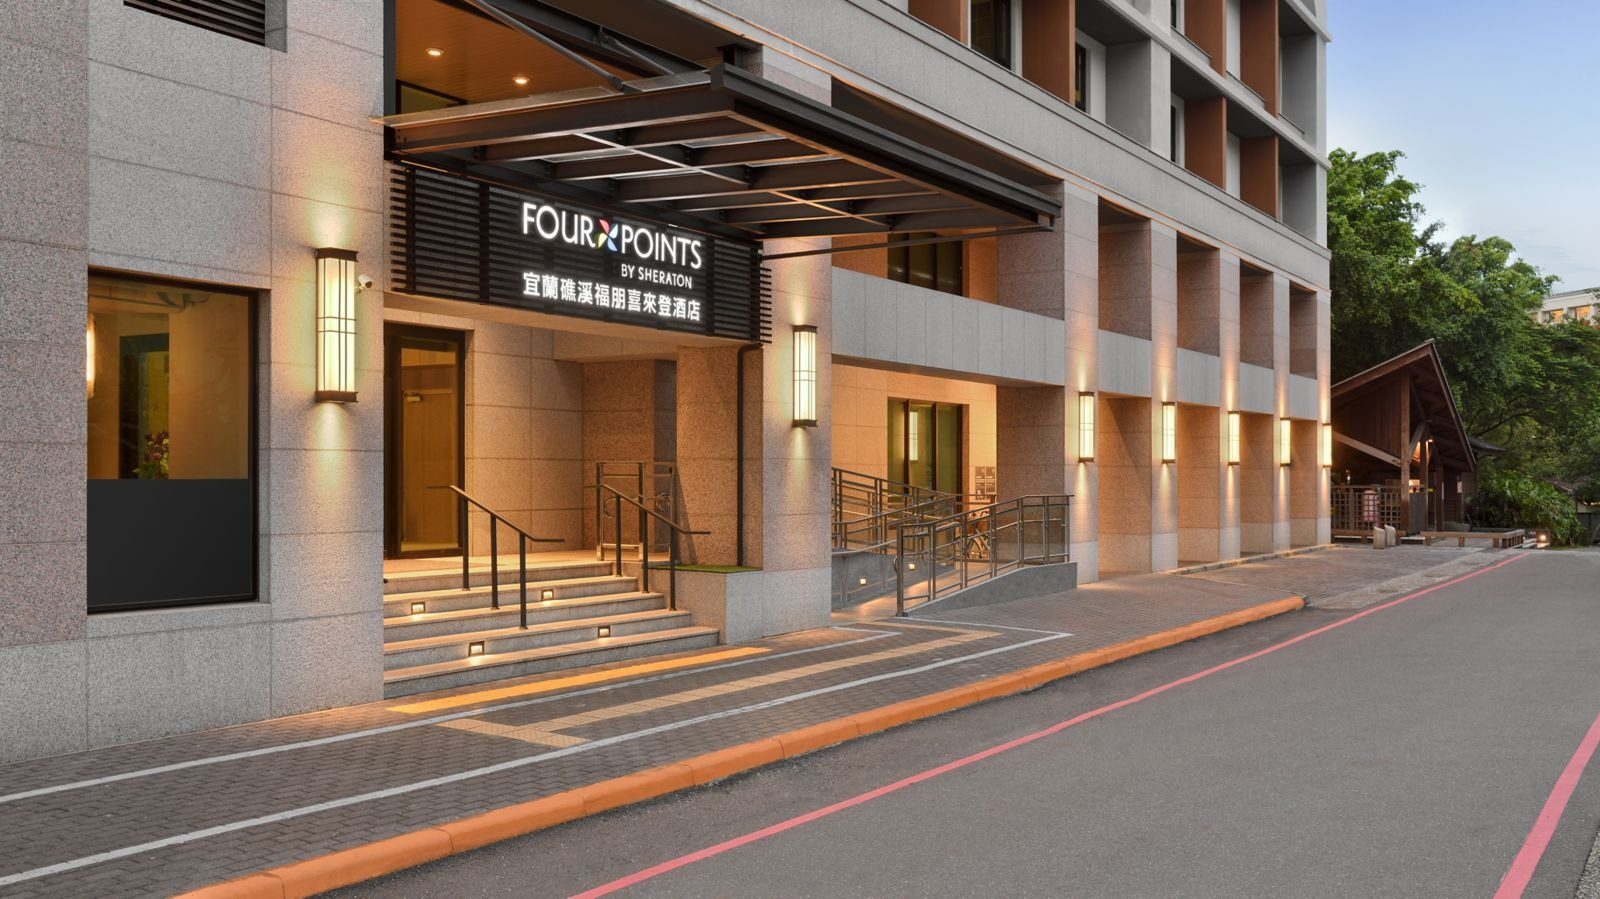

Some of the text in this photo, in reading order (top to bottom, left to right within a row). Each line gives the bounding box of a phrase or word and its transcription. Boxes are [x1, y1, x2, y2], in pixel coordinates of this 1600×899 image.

[522, 202, 702, 269] FOUR POINTS
[522, 271, 701, 322] 宜蘭礁溪福朋喜來登酒店
[621, 263, 692, 289] BY SHERATON
